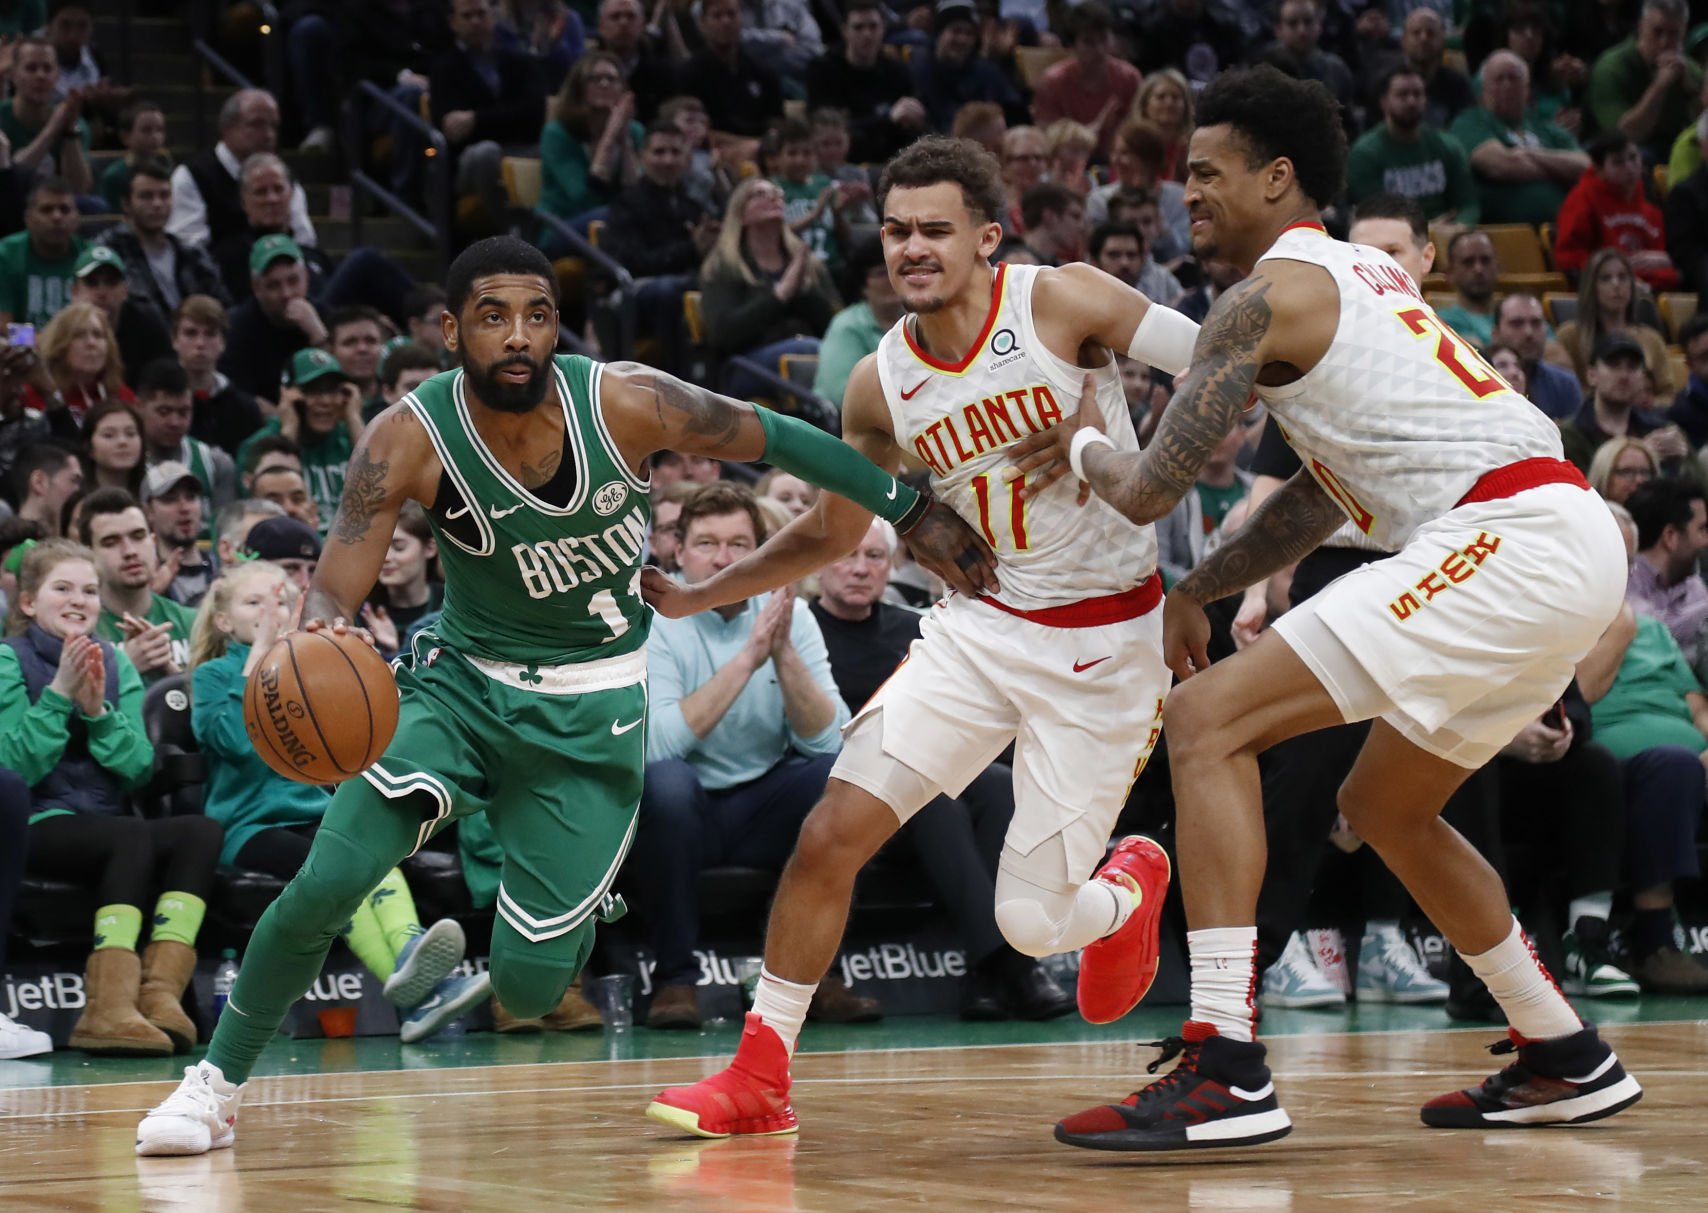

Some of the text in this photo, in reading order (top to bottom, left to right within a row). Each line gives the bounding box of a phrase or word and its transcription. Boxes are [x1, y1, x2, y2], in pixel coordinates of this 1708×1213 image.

[989, 351, 1026, 371] sharecare
[913, 384, 1063, 479] ATLANTA
[971, 472, 1030, 551] 11
[511, 504, 645, 600] BOSTON
[260, 666, 317, 768] SPALDING
[5, 972, 87, 1019] jetB
[840, 943, 965, 988] jetBlue
